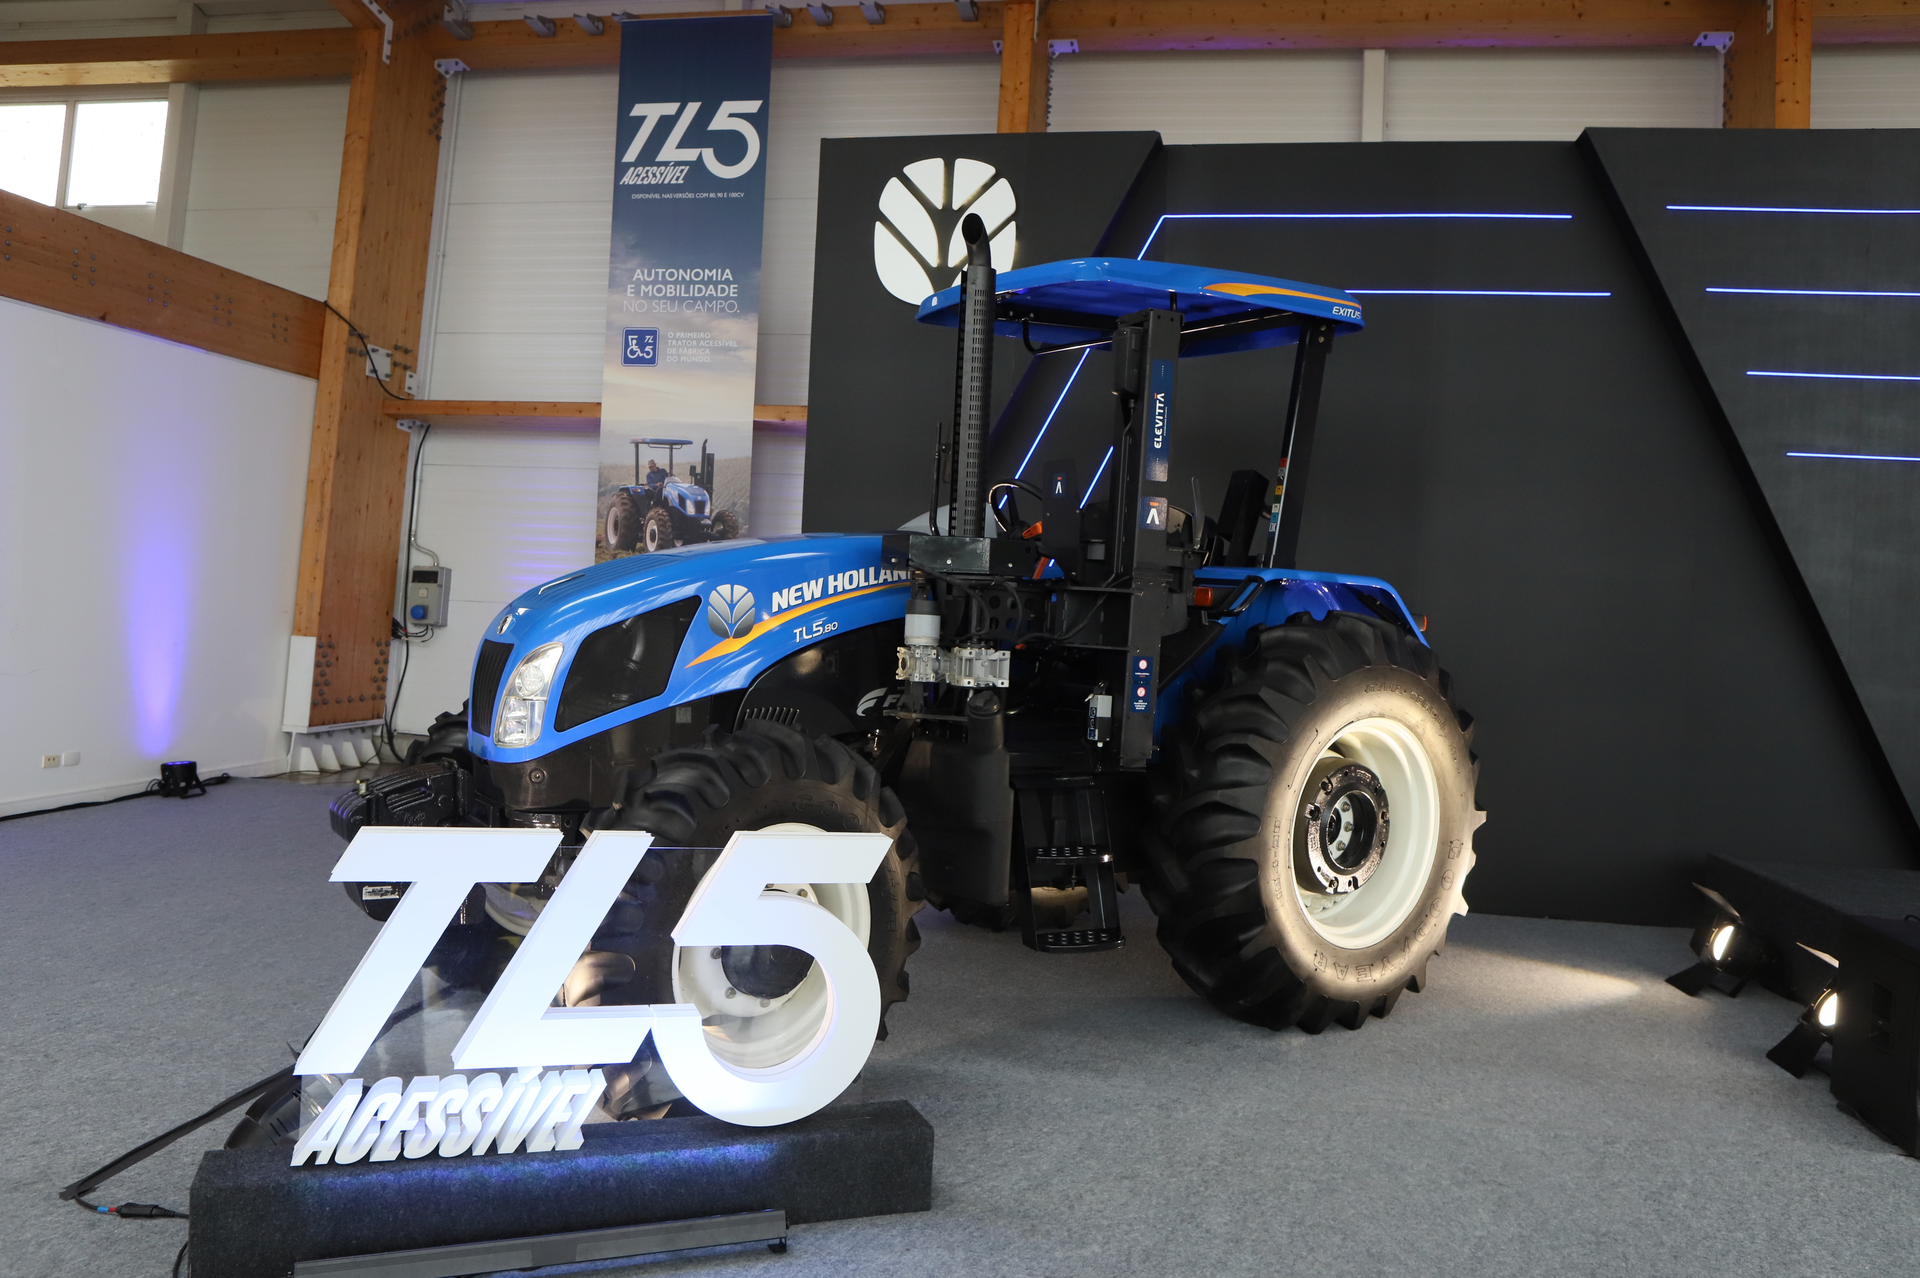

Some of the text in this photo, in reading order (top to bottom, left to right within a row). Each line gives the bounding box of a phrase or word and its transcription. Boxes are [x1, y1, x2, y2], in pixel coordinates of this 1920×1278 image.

[621, 100, 763, 179] TL5
[619, 162, 690, 185] ACESSÍVEL
[632, 269, 734, 281] AUTONOMIA
[626, 284, 738, 297] E MOBILIDADE
[623, 300, 740, 313] NO SEU CAMPO.
[1332, 306, 1361, 319] EXITUS
[699, 339, 738, 347] ACESSÍVEL
[678, 347, 711, 355] FÁBRICA
[772, 577, 824, 613] NEW
[293, 825, 894, 1126] TL5
[290, 1066, 608, 1167] ACESSÍVEL
